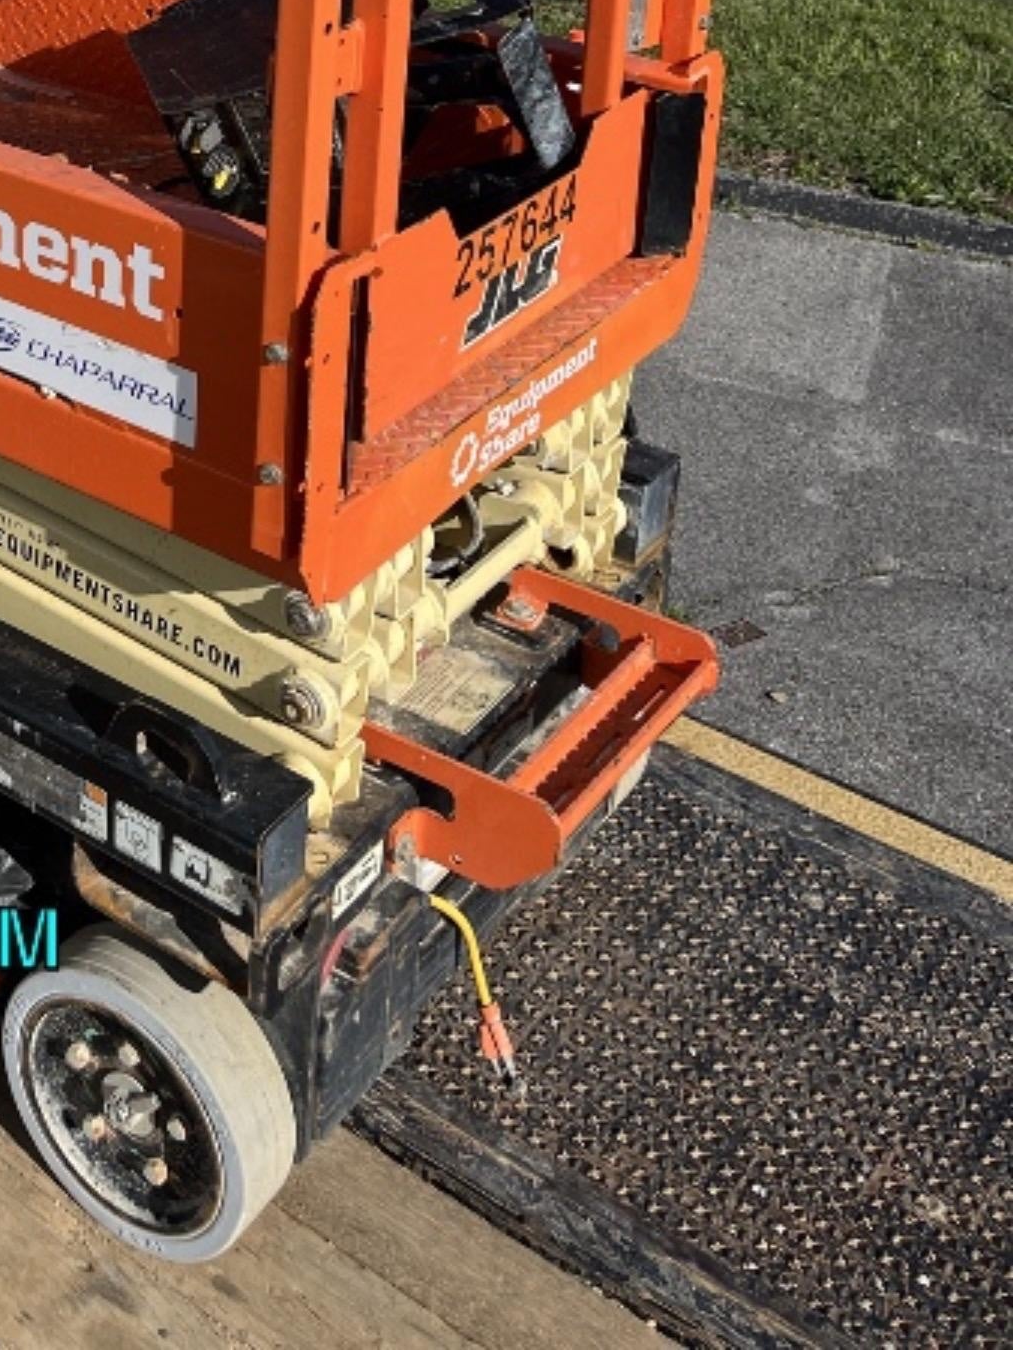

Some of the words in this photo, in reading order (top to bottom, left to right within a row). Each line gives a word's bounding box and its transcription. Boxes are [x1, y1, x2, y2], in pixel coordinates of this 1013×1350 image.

[452, 172, 577, 301] 257644
[24, 335, 196, 423] CHAPARRAL
[485, 337, 598, 435] Equipment
[476, 411, 541, 474] Share
